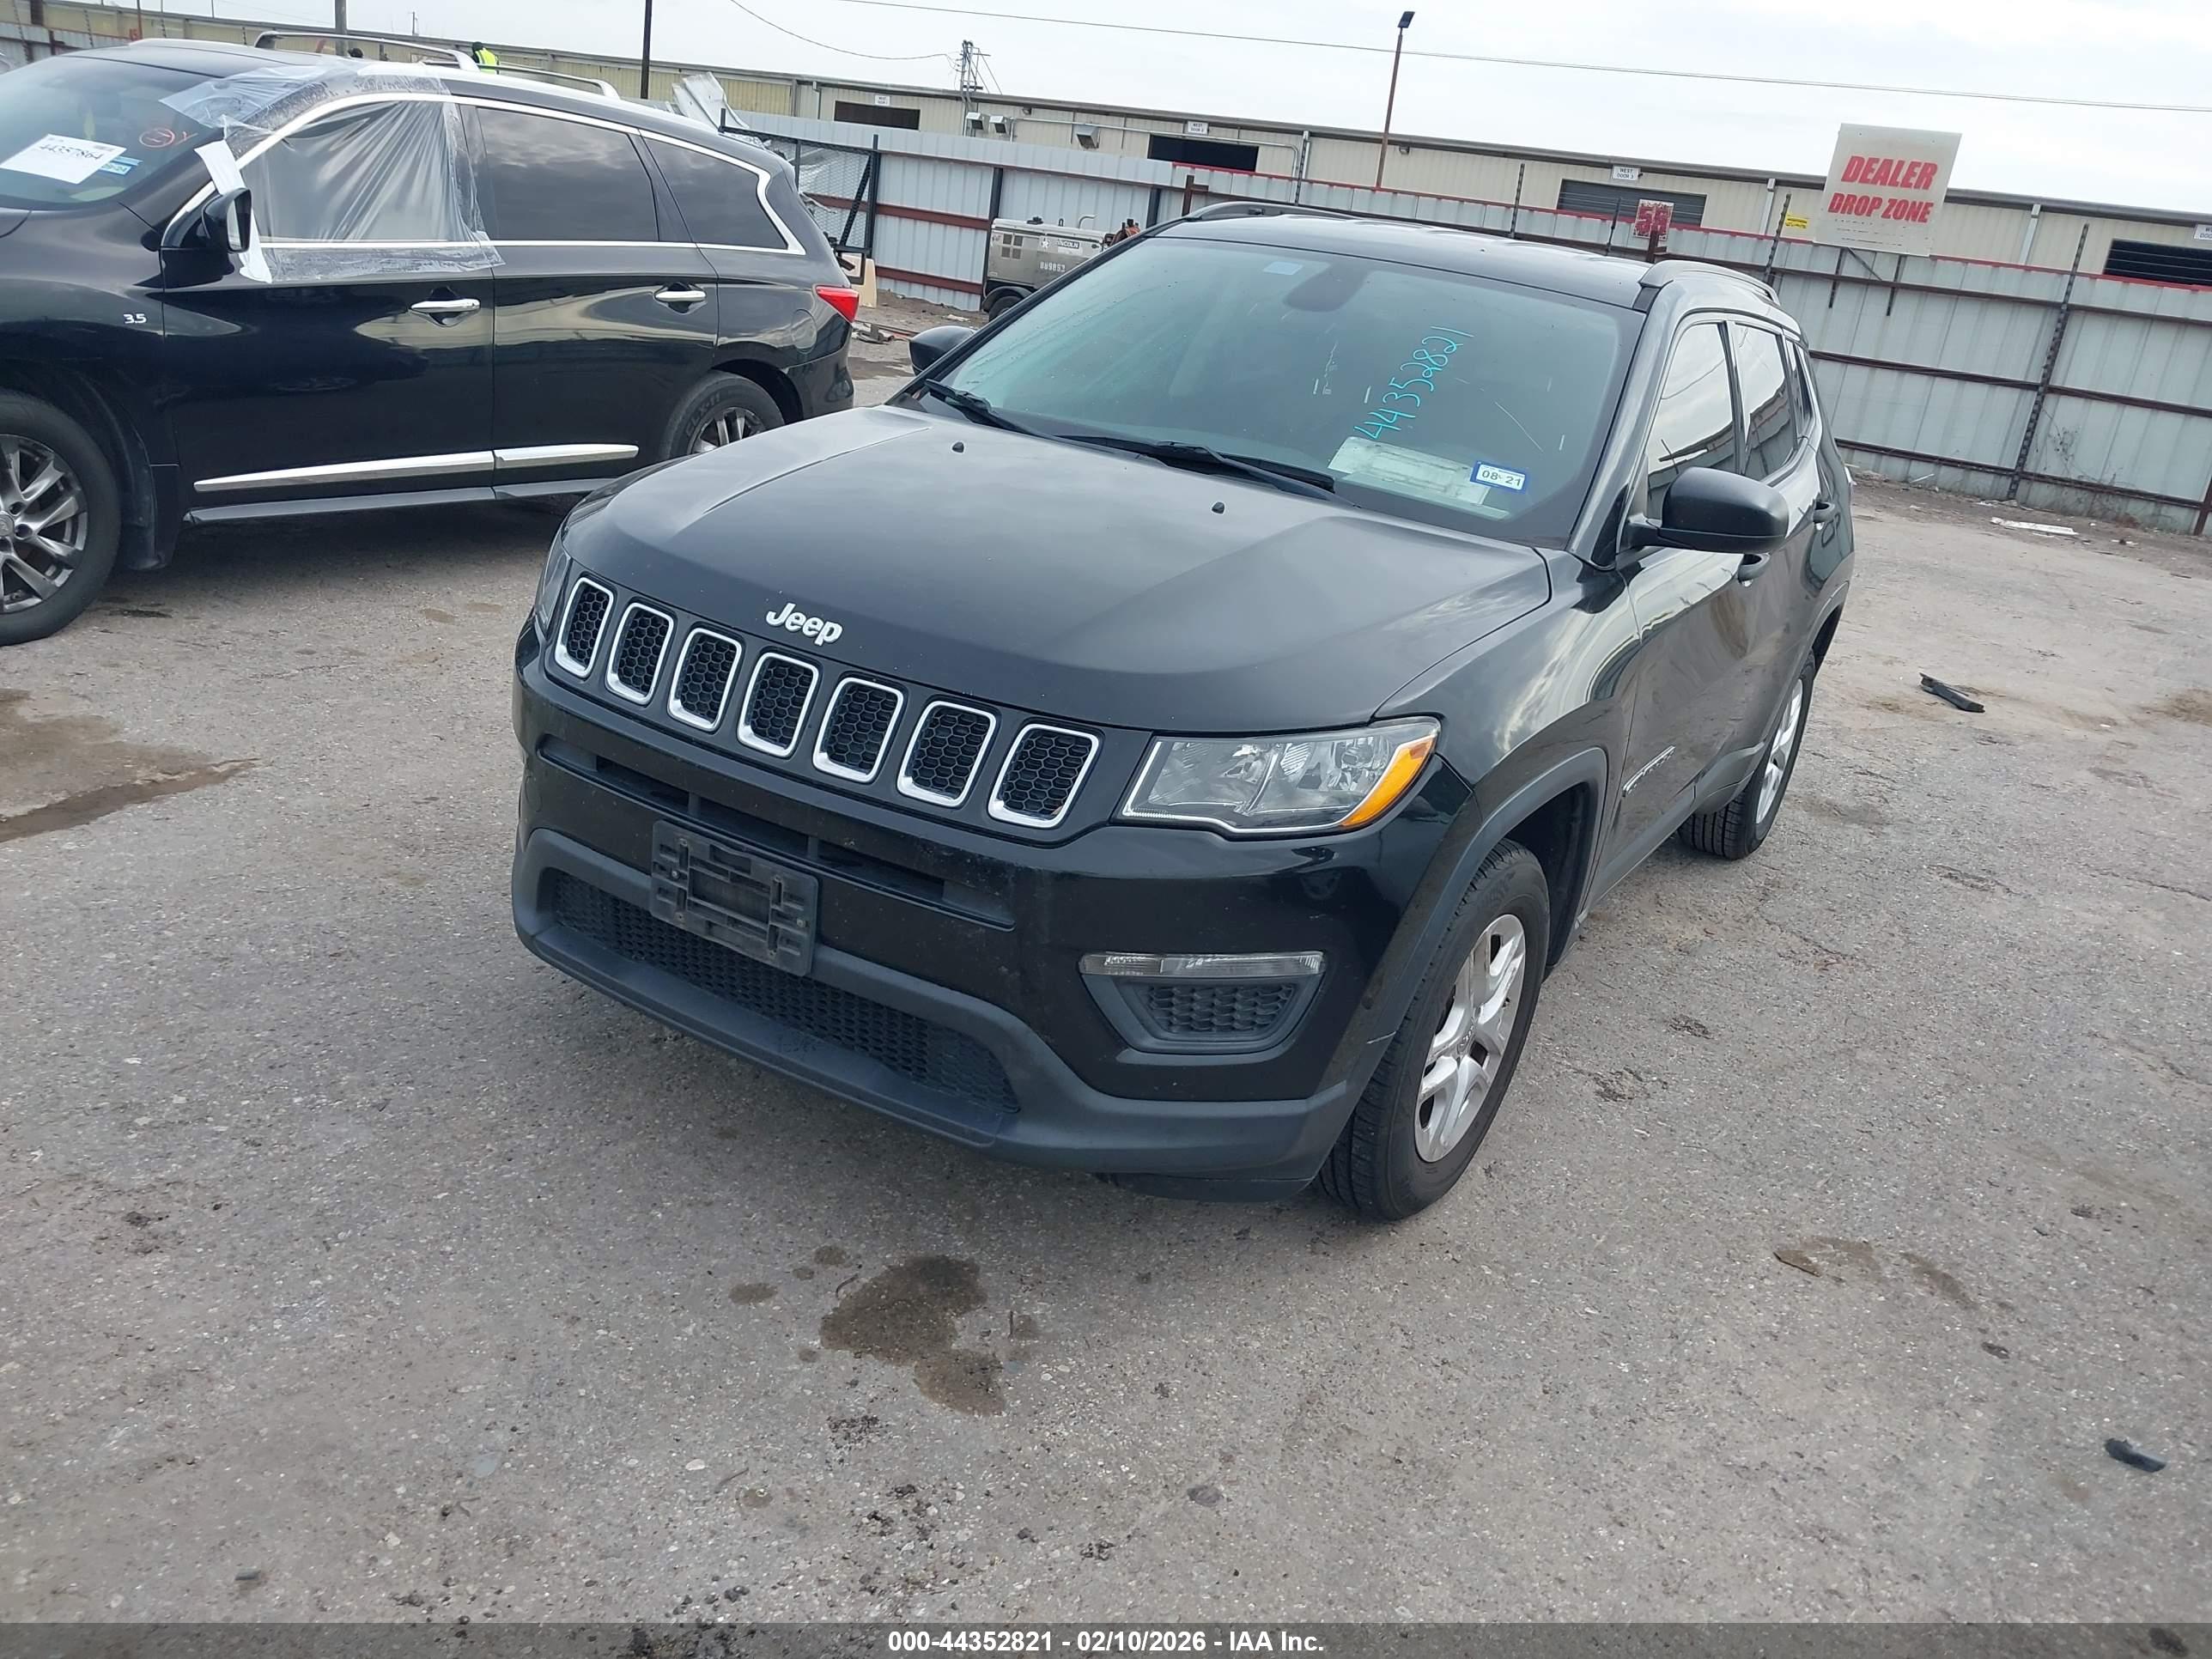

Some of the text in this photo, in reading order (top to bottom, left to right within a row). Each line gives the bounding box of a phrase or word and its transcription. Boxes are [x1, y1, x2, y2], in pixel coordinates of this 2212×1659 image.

[1841, 155, 1938, 191] DEALER
[1827, 192, 1935, 223] DROP ZONE
[1353, 325, 1474, 440] 44352821
[1482, 470, 1522, 487] 08 21
[765, 602, 843, 647] Jeep
